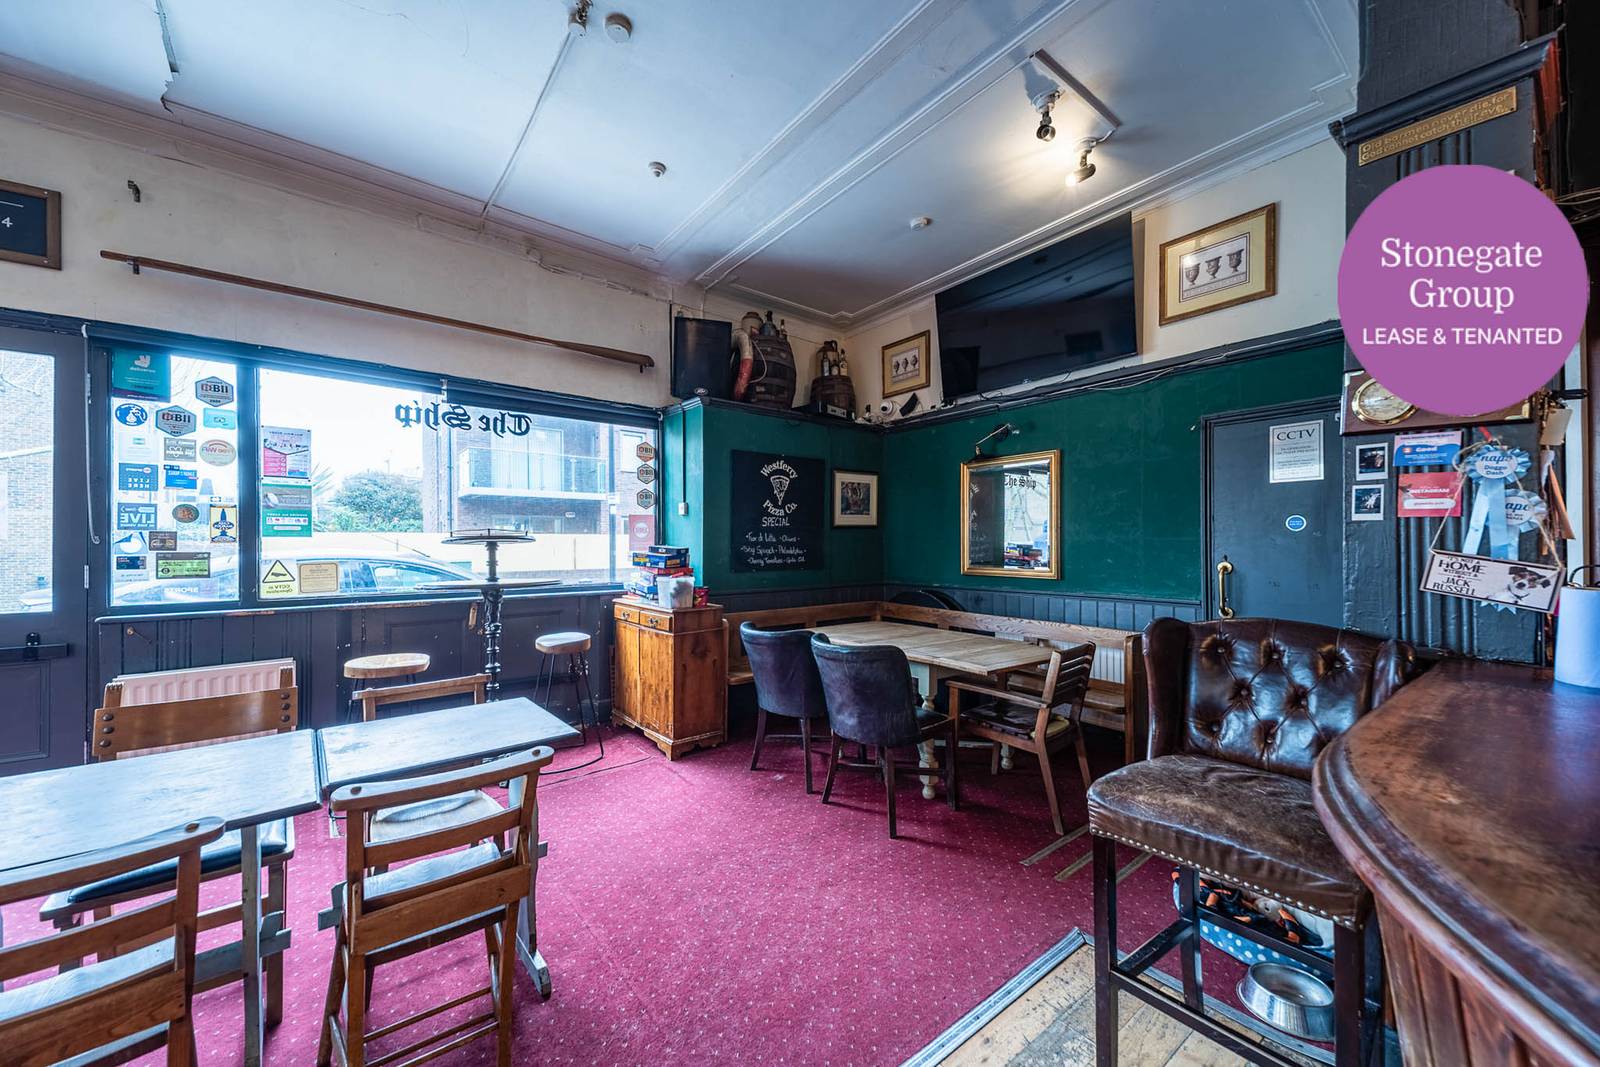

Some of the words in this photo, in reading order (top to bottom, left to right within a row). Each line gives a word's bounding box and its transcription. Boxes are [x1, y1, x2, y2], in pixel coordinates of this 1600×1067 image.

[1362, 139, 1383, 153] Old
[1384, 123, 1430, 144] barmen
[1432, 109, 1466, 126] never
[1492, 93, 1511, 105] for
[1361, 146, 1383, 161] God
[1383, 134, 1419, 152] cannot
[1420, 123, 1451, 139] catch
[1451, 113, 1480, 129] their
[1276, 428, 1316, 441] CCTV
[760, 459, 798, 479] Westferry
[762, 499, 785, 516] Pizza
[761, 516, 790, 527] SPECIAL
[1438, 559, 1488, 575] HOME
[1443, 568, 1472, 577] WITHOUT
[1432, 581, 1476, 596] RUSSELL
[1442, 577, 1472, 588] JACK
